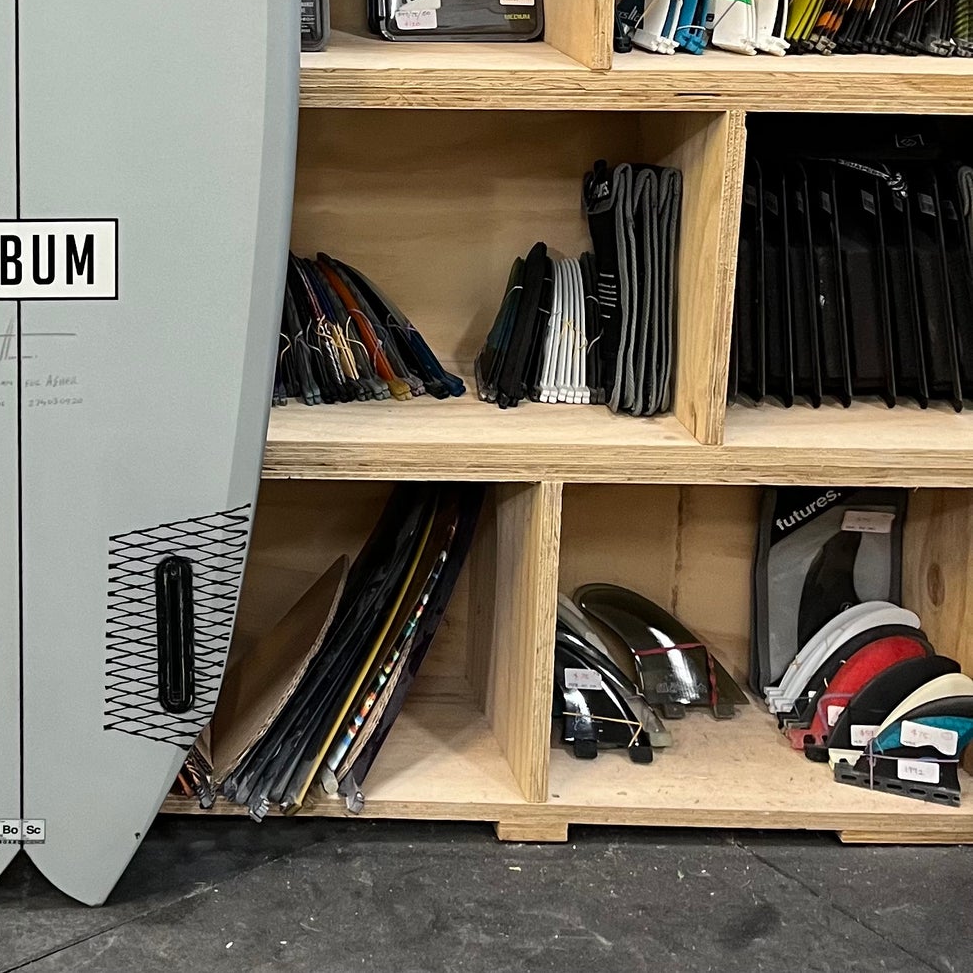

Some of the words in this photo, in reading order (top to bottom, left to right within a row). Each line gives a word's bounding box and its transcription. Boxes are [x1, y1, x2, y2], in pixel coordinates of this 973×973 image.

[776, 489, 842, 532] futures.
[2, 824, 19, 835] Bo
[26, 824, 42, 835] Sc
